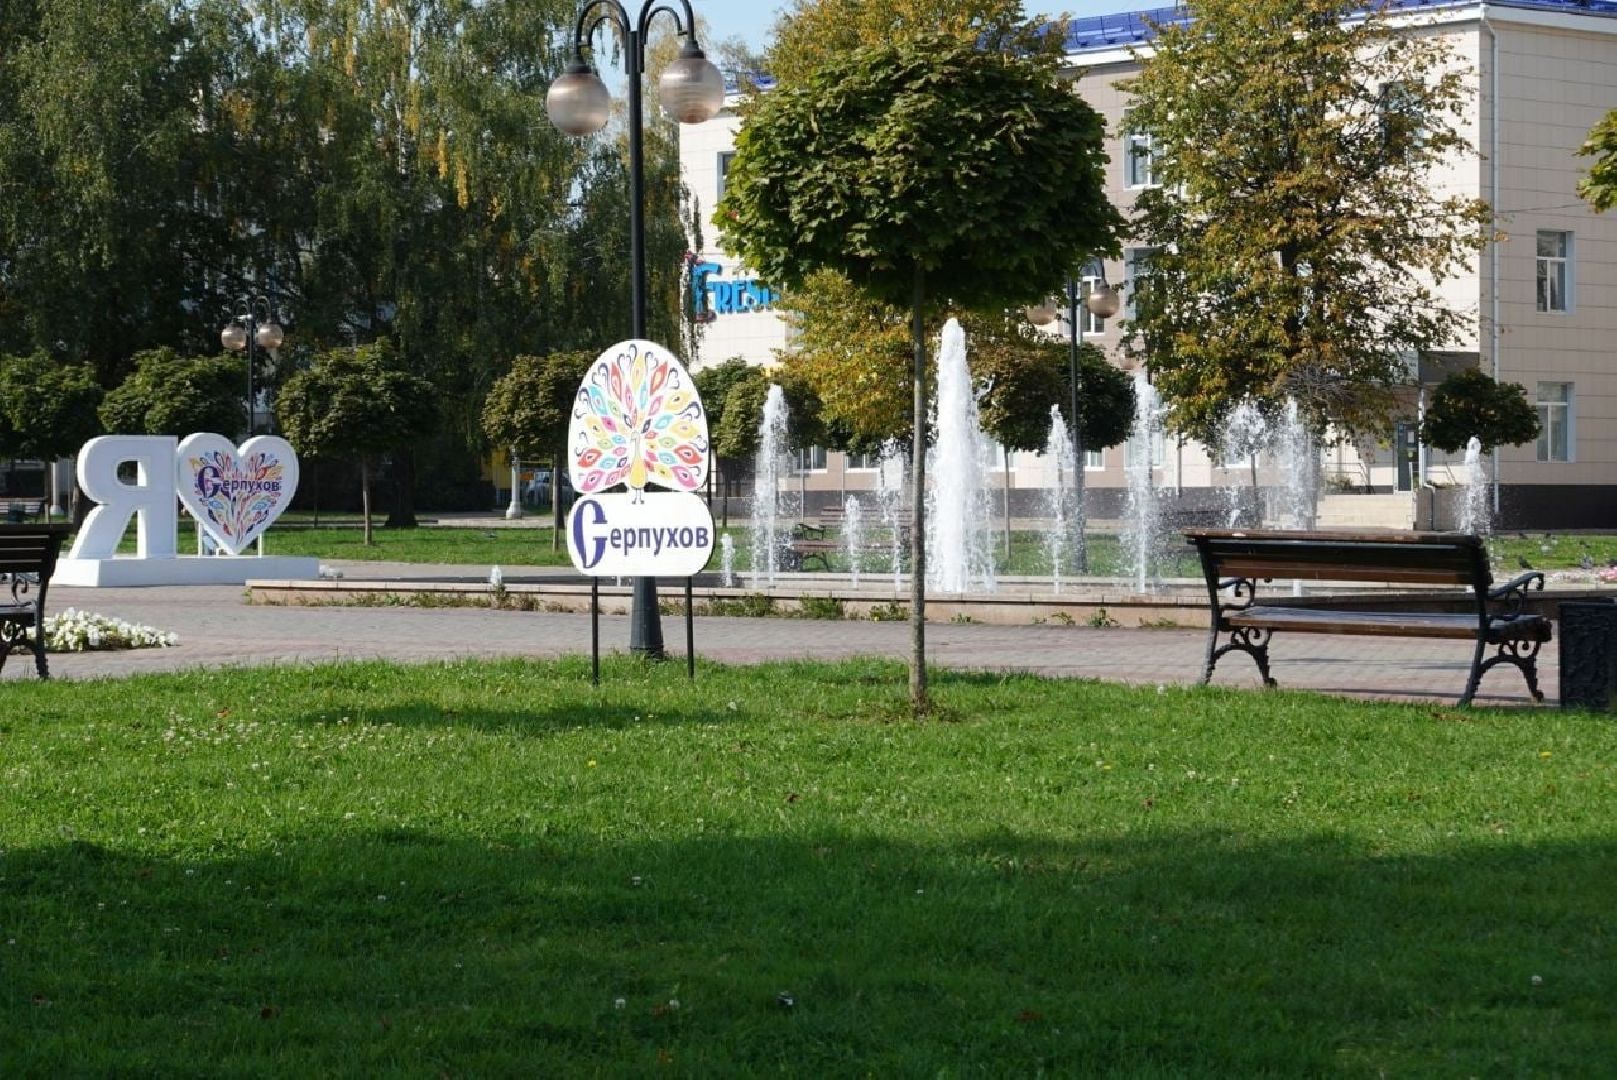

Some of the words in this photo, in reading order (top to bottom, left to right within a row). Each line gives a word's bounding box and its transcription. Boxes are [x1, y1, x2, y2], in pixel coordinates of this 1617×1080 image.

[70, 435, 178, 559] Я
[198, 465, 281, 499] Серпухов
[572, 499, 709, 569] Серпухов
